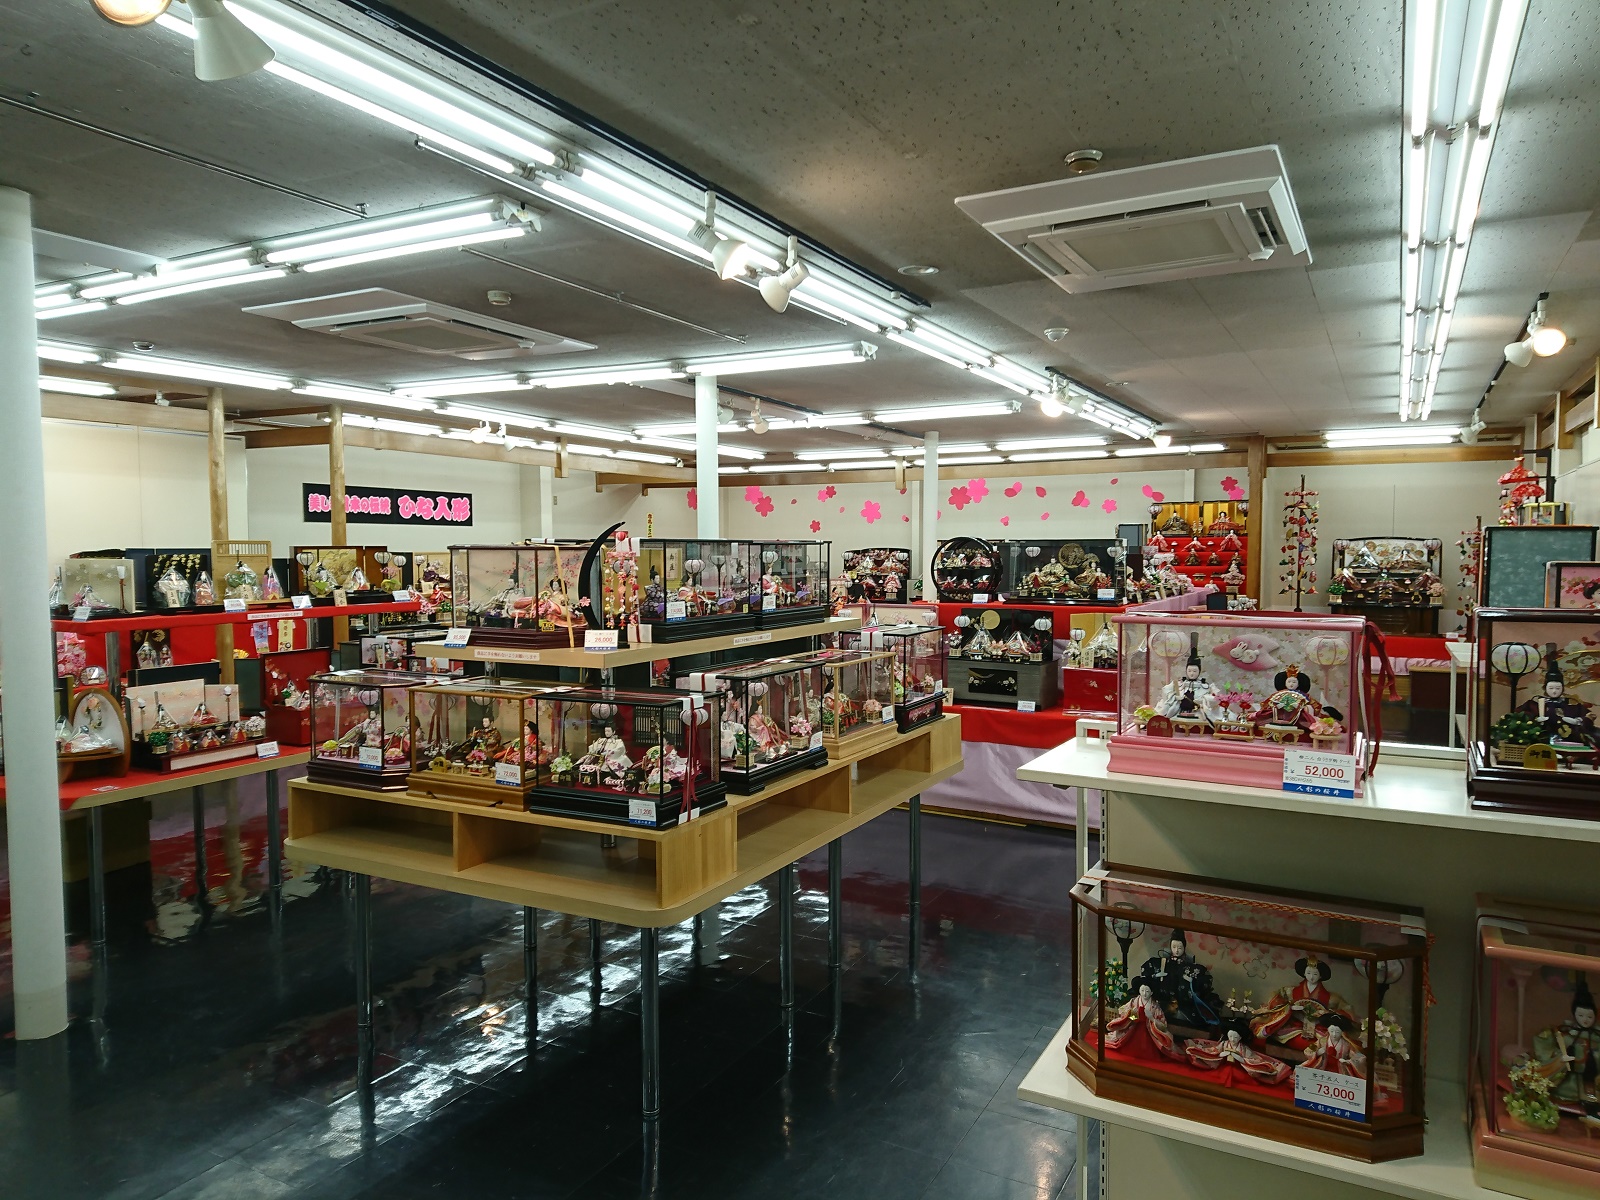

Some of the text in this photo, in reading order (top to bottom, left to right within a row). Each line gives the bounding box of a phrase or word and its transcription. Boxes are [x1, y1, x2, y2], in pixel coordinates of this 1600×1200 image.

[308, 493, 471, 522] 美し本の伝統 ひな人形
[1304, 765, 1344, 779] 52,000
[1316, 1083, 1355, 1101] 73,000
